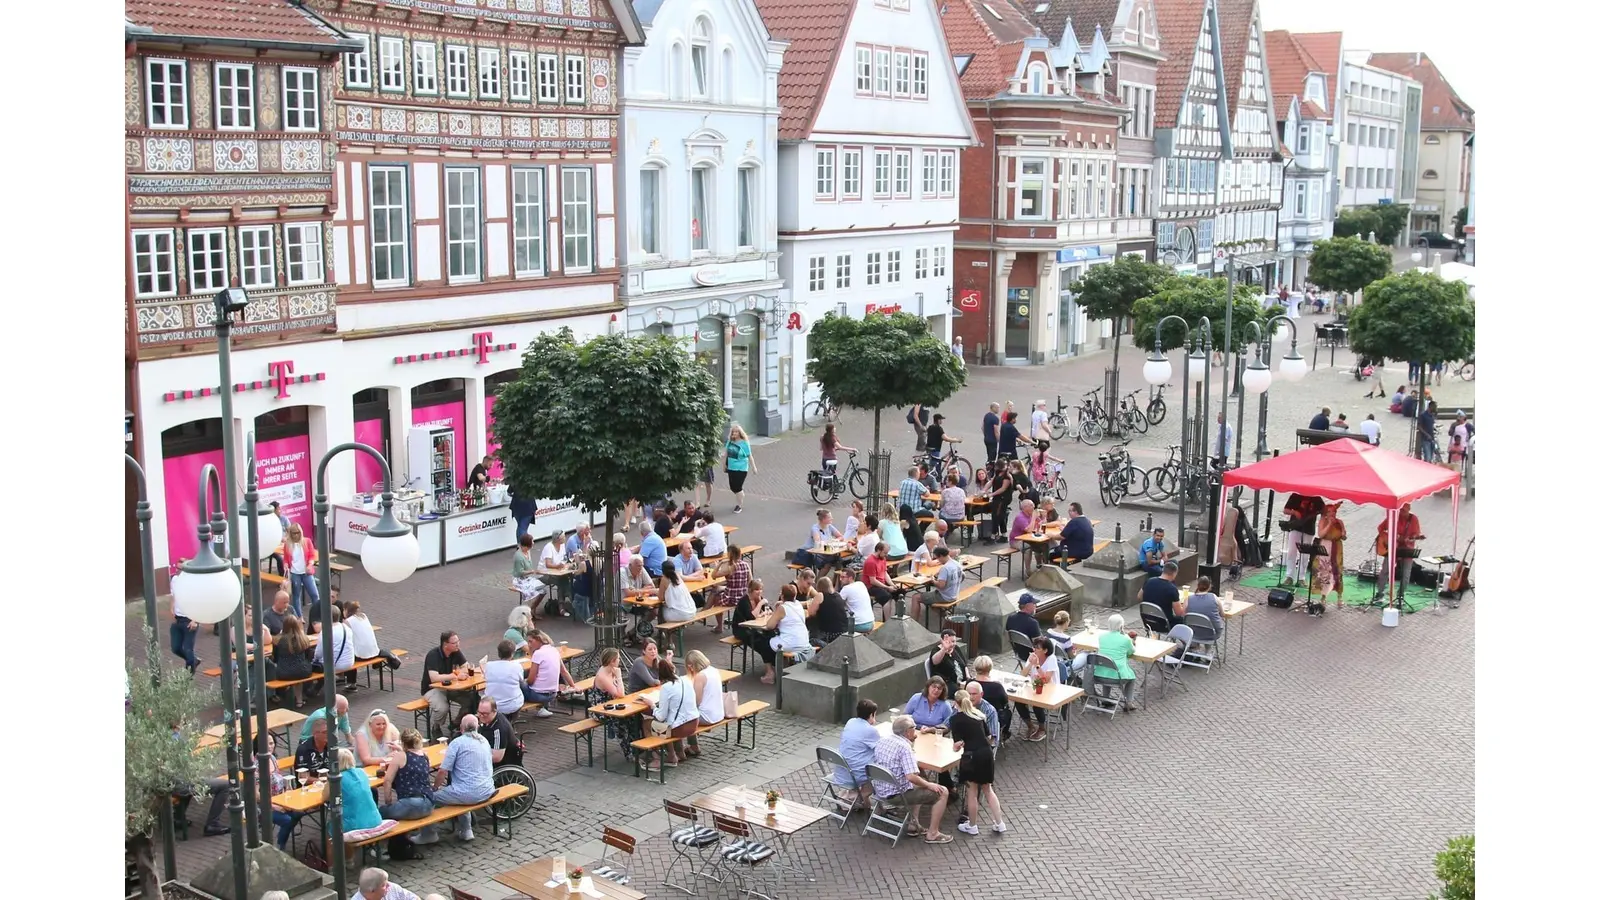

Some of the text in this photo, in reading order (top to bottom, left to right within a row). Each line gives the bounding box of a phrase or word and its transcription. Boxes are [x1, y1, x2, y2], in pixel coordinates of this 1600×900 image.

[472, 331, 493, 364] T
[267, 359, 294, 399] T
[279, 452, 305, 464] ZUKUNFT
[265, 463, 294, 474] IMMER AN
[263, 472, 297, 484] IHRER SEITE
[482, 516, 507, 529] DAMKE
